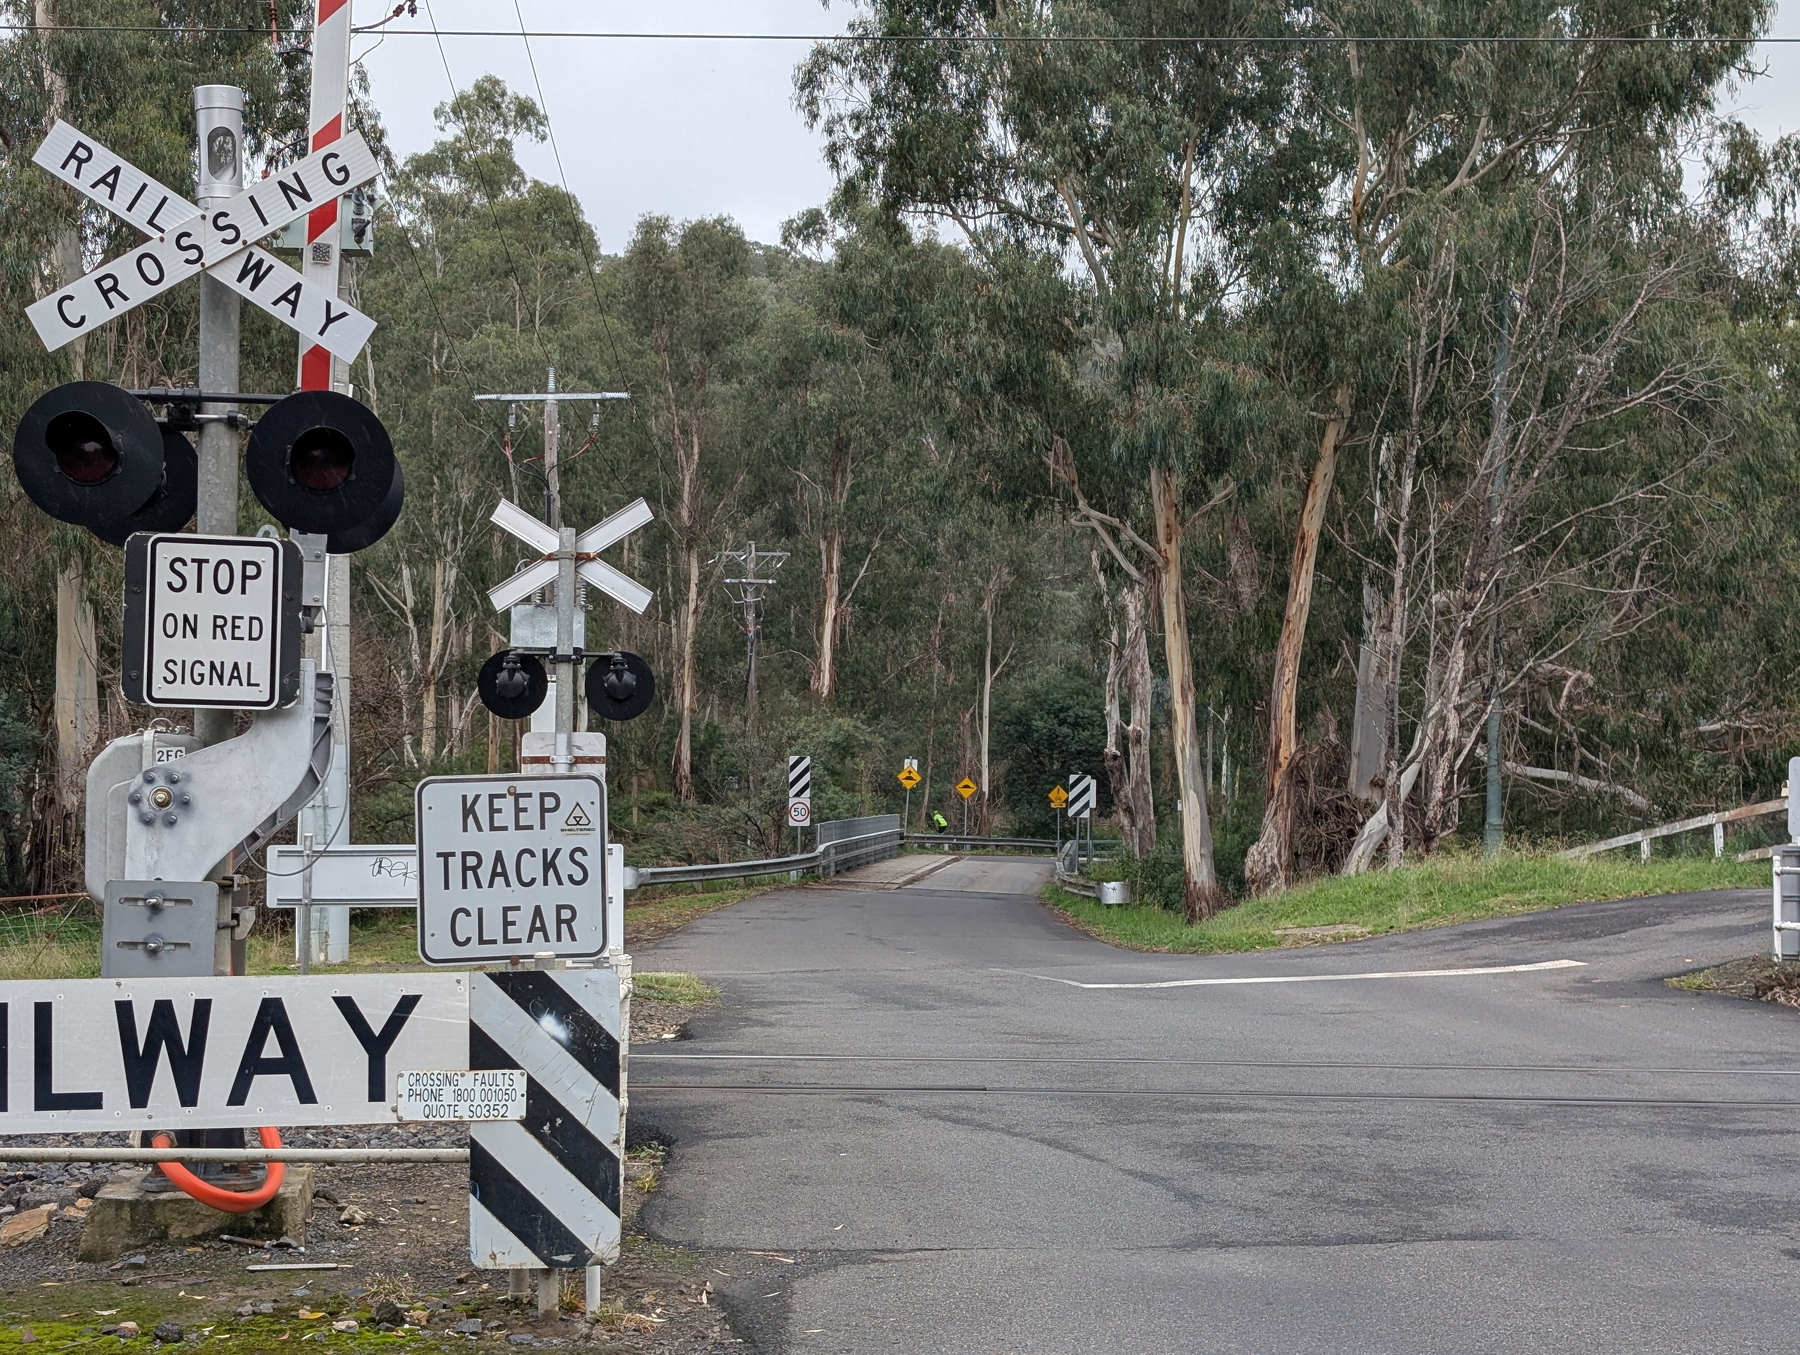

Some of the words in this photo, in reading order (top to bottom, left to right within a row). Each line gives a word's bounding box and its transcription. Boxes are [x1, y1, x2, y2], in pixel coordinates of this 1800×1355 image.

[57, 152, 350, 329] CROSSING
[60, 140, 169, 234] RAIL
[236, 250, 350, 337] WAY
[166, 556, 262, 595] STOP
[162, 612, 198, 639] ON
[212, 614, 264, 641] RED
[162, 659, 260, 687] SIGNAL
[461, 791, 561, 833] KEEP
[793, 807, 807, 817] 50
[436, 846, 589, 891] TRACKS
[450, 904, 578, 947] CLEAR
[408, 1073, 459, 1088] CROSSING
[473, 1073, 515, 1087] FAULTS
[408, 1088, 444, 1102] PHONE
[452, 1088, 476, 1102] 1800
[479, 1088, 517, 1102] 001050
[423, 1104, 459, 1119] QUOTE
